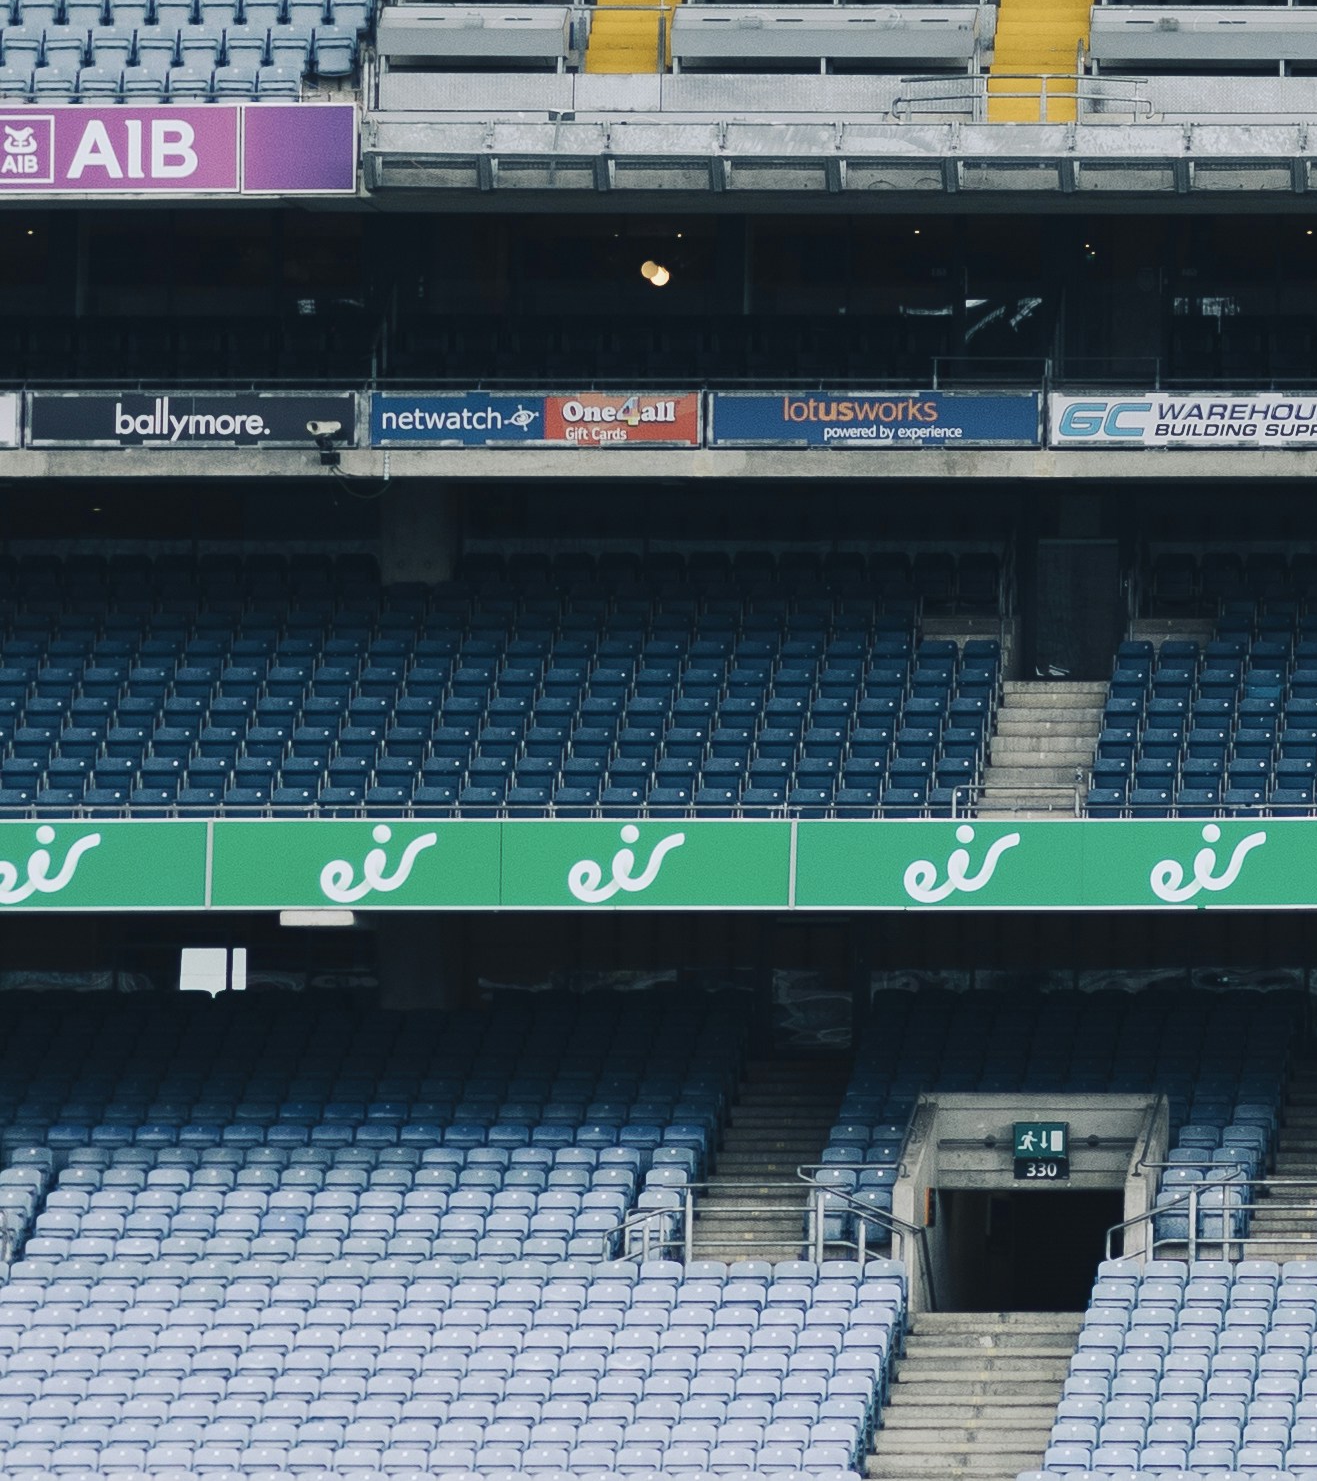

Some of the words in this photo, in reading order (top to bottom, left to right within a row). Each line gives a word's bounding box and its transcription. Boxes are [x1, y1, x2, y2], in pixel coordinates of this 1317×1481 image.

[66, 119, 199, 179] AIB
[1, 155, 38, 174] AIB
[115, 396, 271, 442] ballymore.
[382, 405, 501, 431] netwatch
[562, 396, 676, 426] One4all
[783, 397, 938, 422] lotusworks
[1059, 402, 1153, 437] GC
[565, 427, 588, 440] Gift
[591, 427, 627, 440] Cards
[823, 424, 876, 442] powered
[879, 424, 895, 442] by
[897, 424, 963, 442] experience
[1155, 424, 1257, 436] BUILDING
[320, 824, 438, 903] eir
[568, 824, 685, 903] eir
[903, 824, 1020, 903] eir
[1150, 823, 1267, 903] eir
[1026, 1163, 1057, 1177] 330
